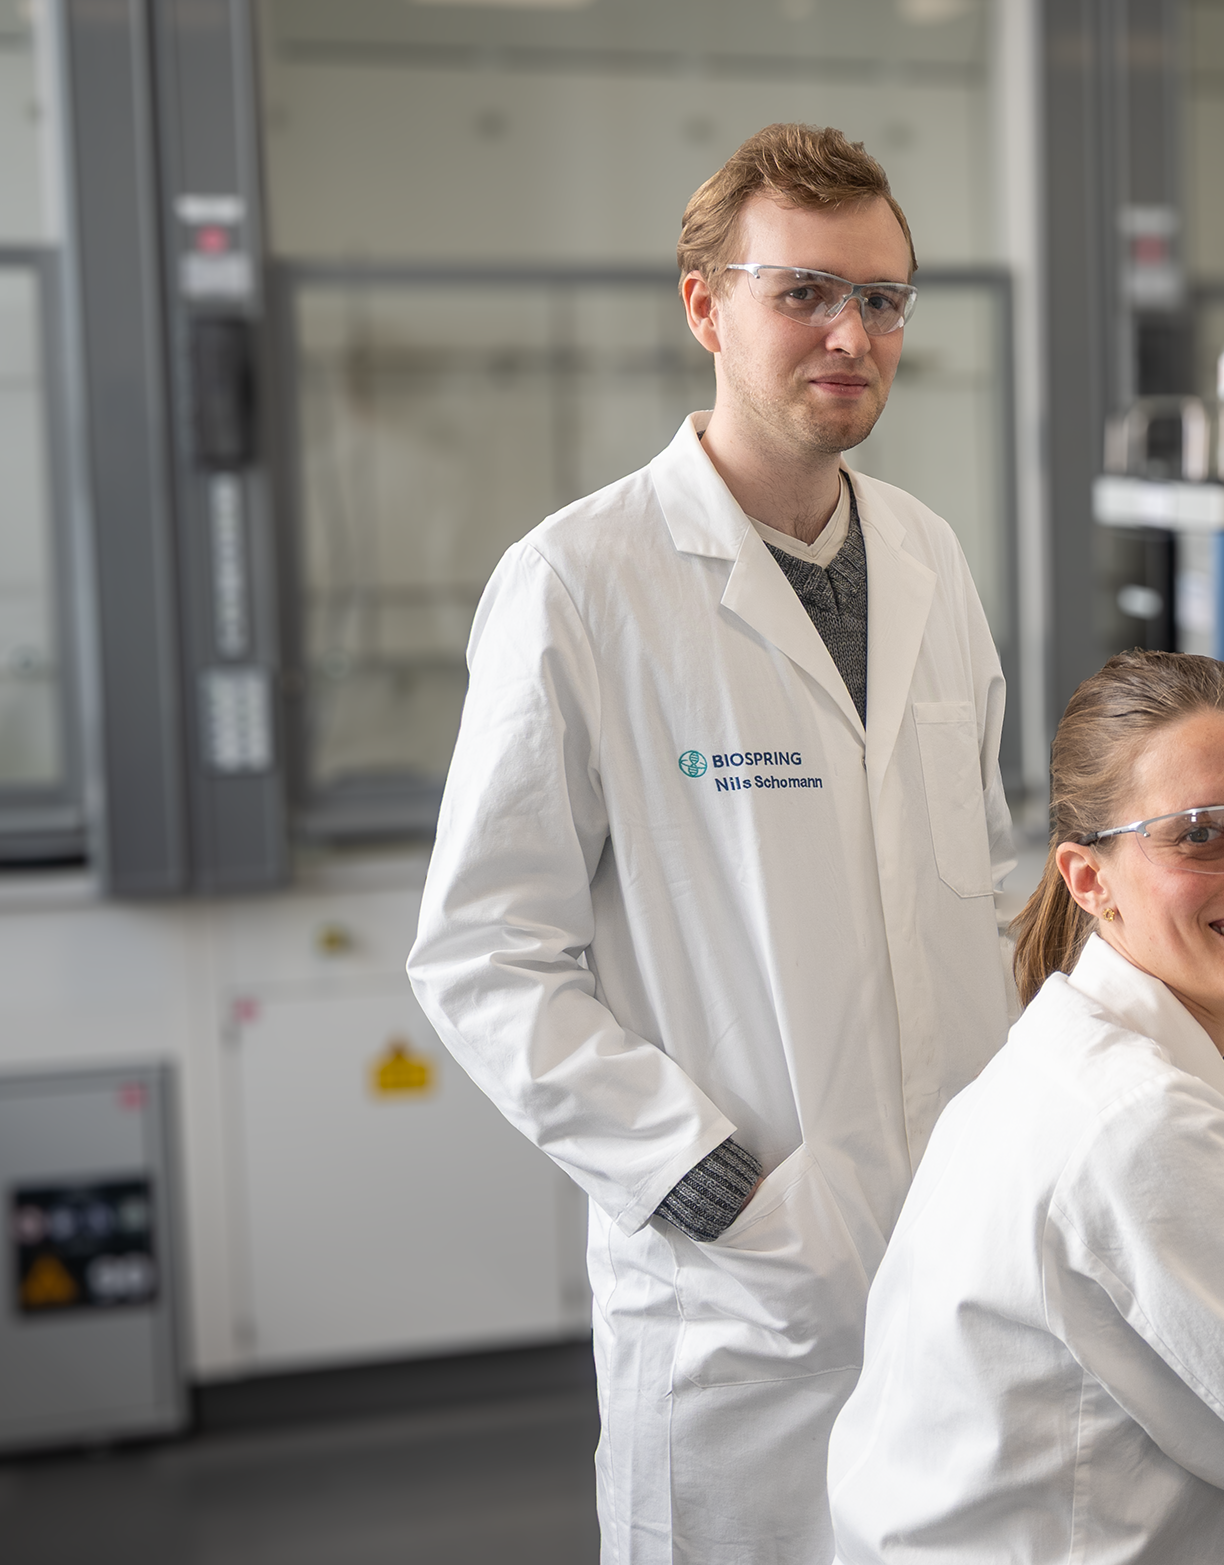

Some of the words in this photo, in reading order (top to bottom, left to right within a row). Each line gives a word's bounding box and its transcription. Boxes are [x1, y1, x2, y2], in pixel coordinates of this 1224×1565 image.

[712, 752, 802, 768] BIOSPRING
[715, 777, 752, 792] Nils
[754, 775, 823, 789] Schomann
